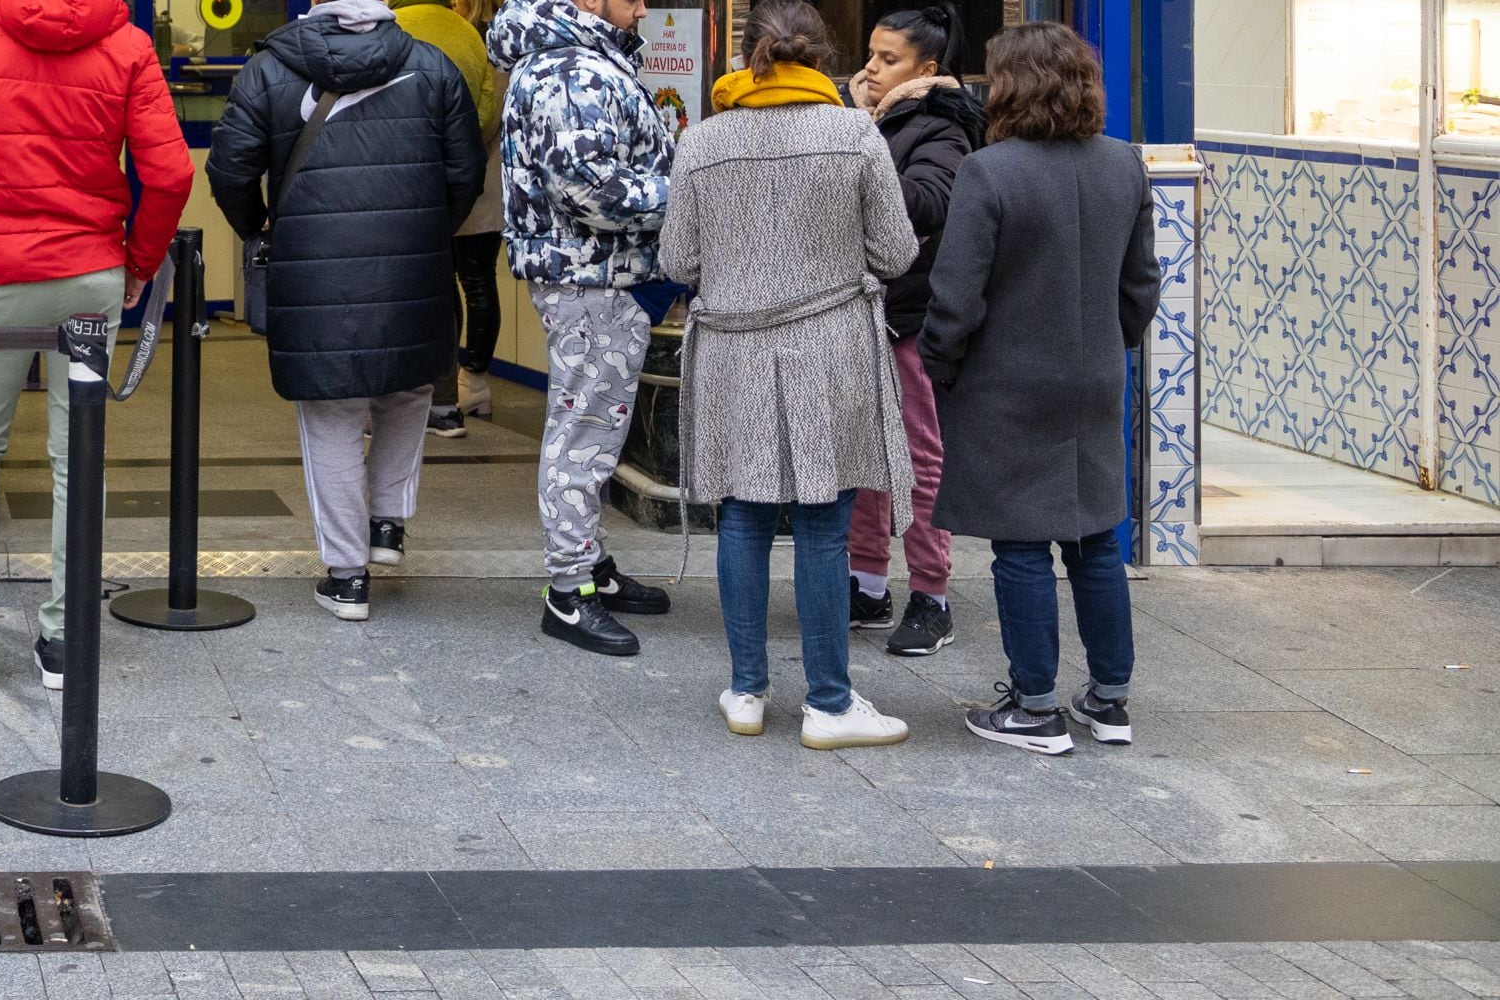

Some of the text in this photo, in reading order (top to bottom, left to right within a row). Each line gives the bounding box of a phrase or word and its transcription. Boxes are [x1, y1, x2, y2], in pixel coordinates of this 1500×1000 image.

[663, 30, 676, 39] HAY
[651, 42, 687, 52] LOTERIA DE
[645, 56, 694, 72] NAVIDAD
